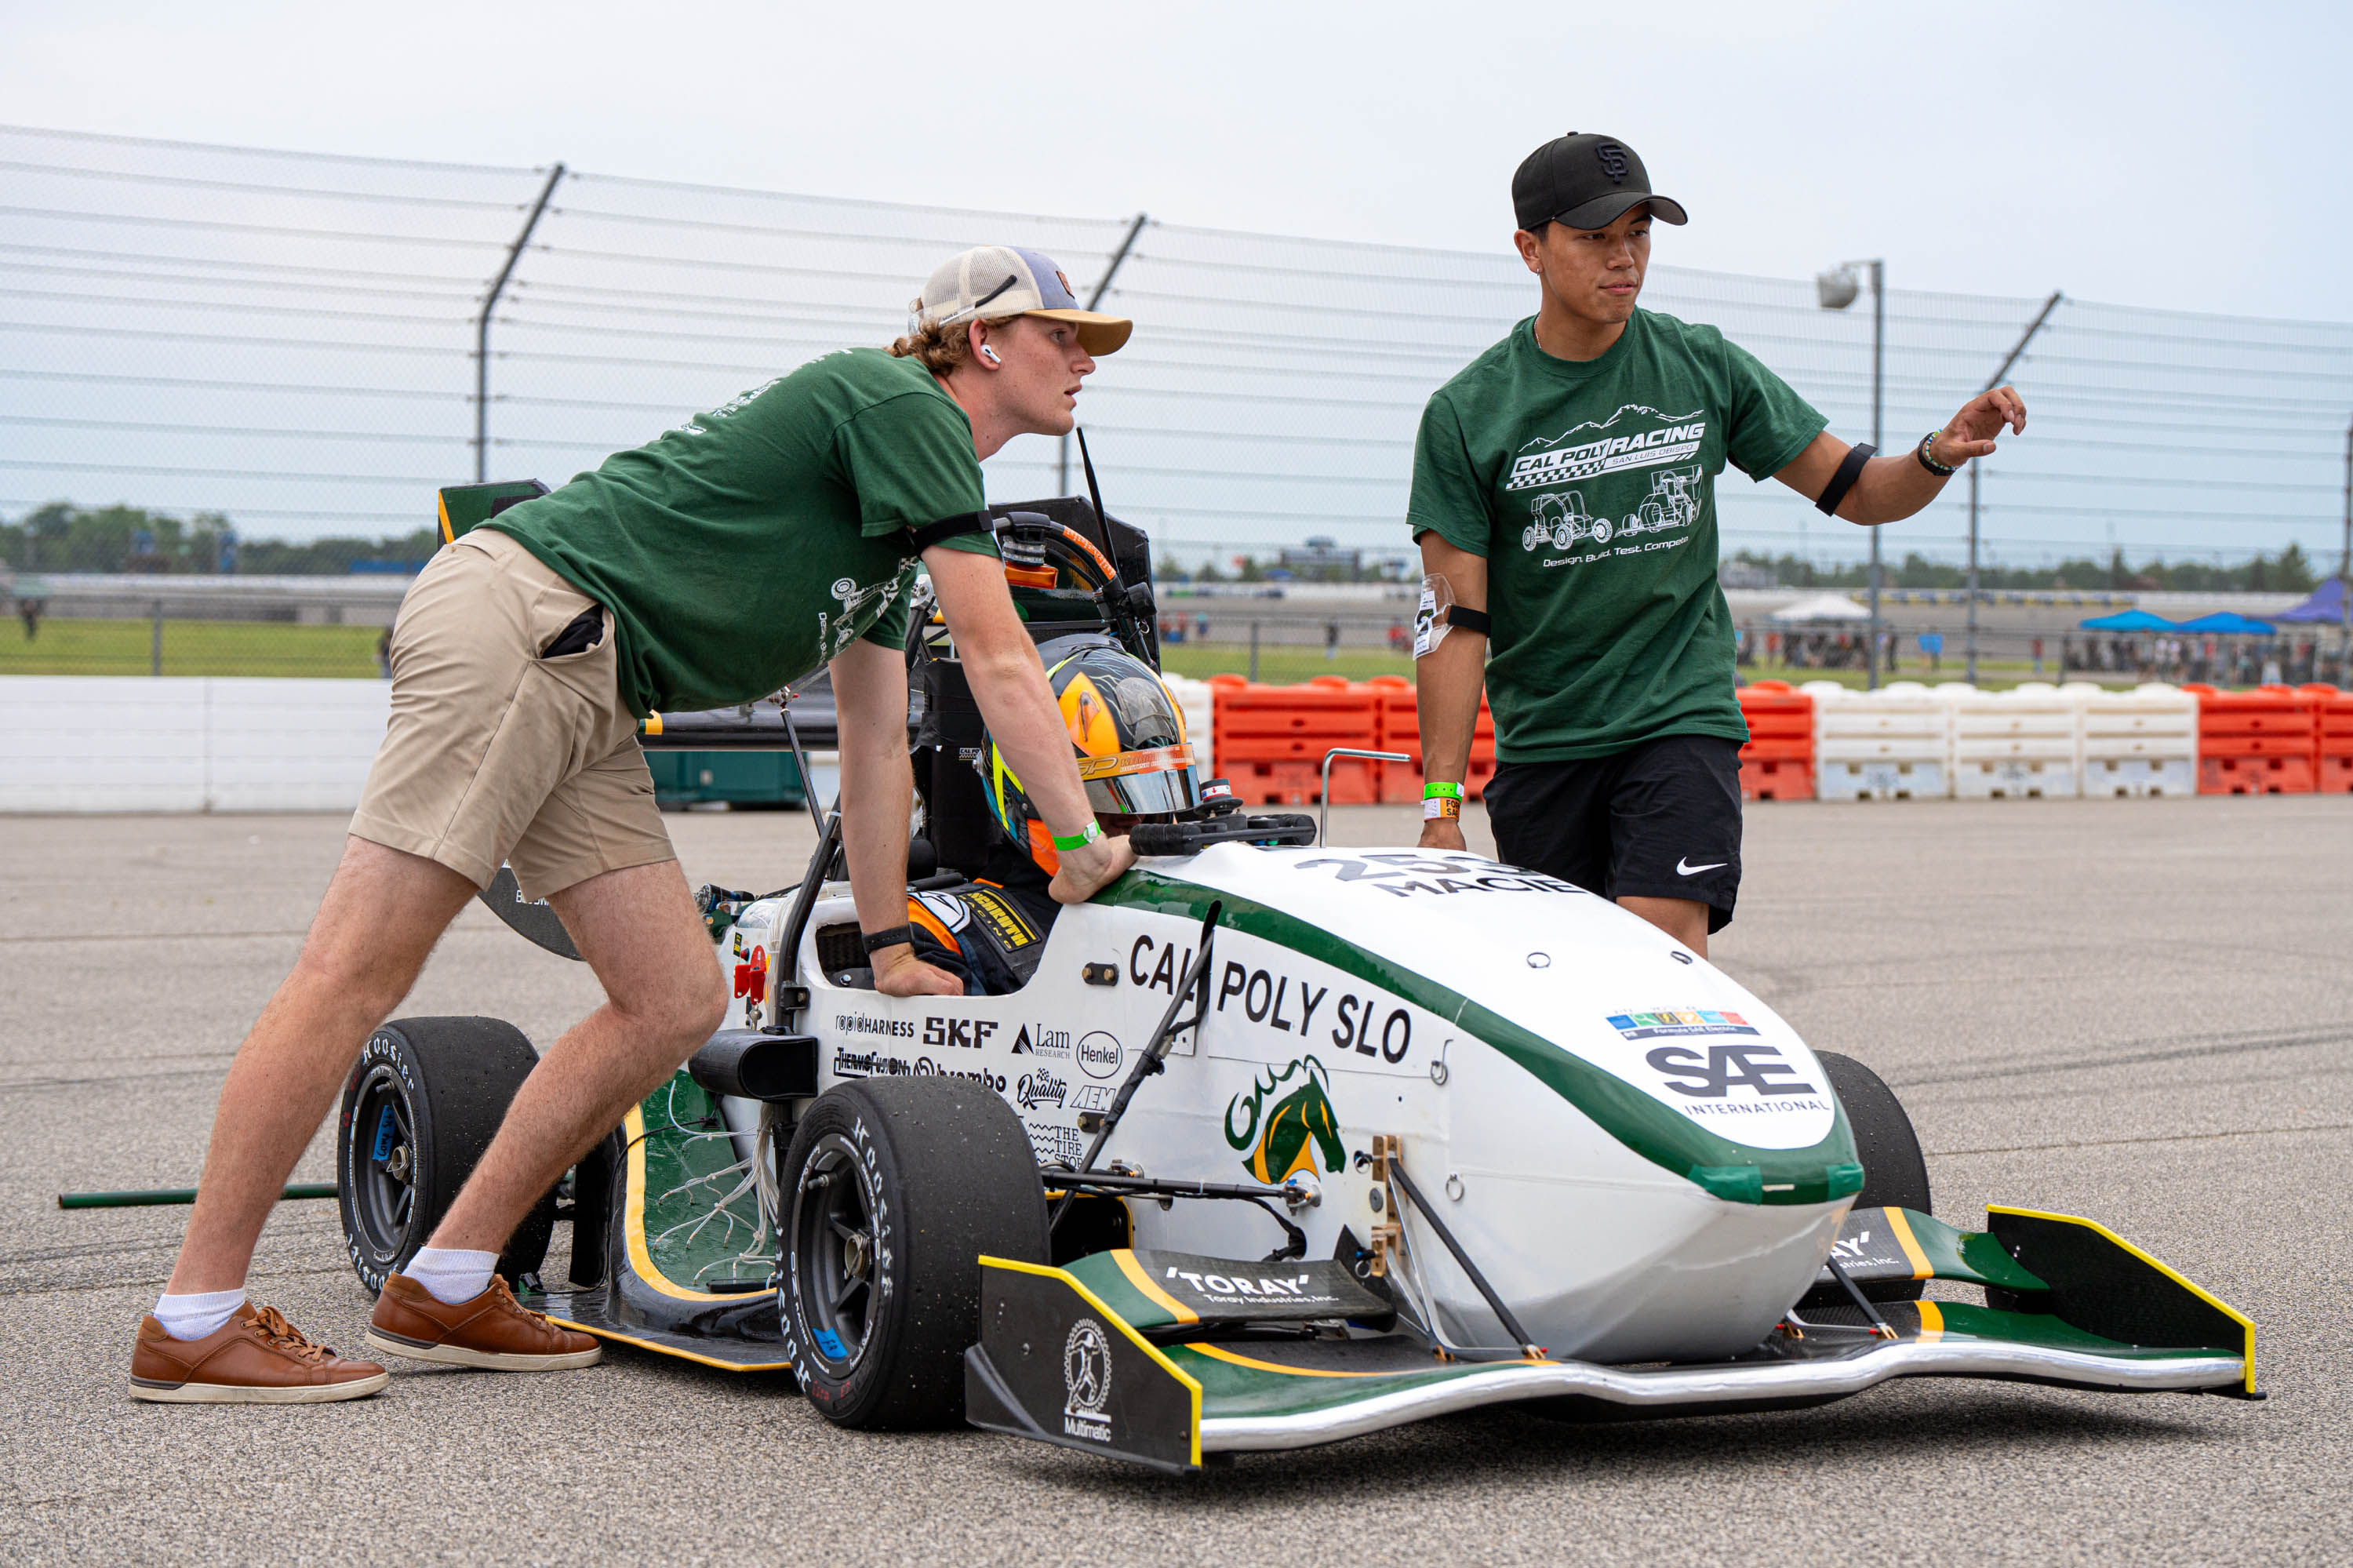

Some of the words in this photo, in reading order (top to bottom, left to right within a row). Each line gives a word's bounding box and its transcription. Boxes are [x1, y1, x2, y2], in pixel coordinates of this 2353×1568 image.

[1515, 455, 1555, 473] CAL
[1560, 443, 1609, 464] POLY
[1609, 421, 1706, 456] RACING
[1612, 457, 1632, 465] SAN
[1635, 450, 1657, 460] LUIS
[1658, 443, 1693, 456] OBISPO
[1543, 555, 1584, 567] Design.
[1613, 545, 1642, 555] Test.
[967, 892, 1029, 947] SCHROTH
[1130, 934, 1195, 1002] CAL
[1217, 960, 1329, 1037] POLY
[1332, 994, 1412, 1064] SLO
[835, 1011, 915, 1038] rapidHARNESS
[922, 1017, 998, 1049] SKF
[1035, 1023, 1071, 1050] Lam
[362, 1036, 415, 1093] Hoosier
[1035, 1048, 1071, 1060] RESEARCH
[1081, 1044, 1118, 1064] Henkel
[1646, 1045, 1818, 1097] SAE
[1017, 1073, 1067, 1111] Quality
[1070, 1084, 1117, 1112] AEM
[1683, 1099, 1831, 1116] INTERNATIONAL
[1054, 1125, 1080, 1142] THE
[1053, 1139, 1082, 1156] TIRE
[1203, 1294, 1245, 1305] Toray
[1064, 1417, 1111, 1442] Multimatic
